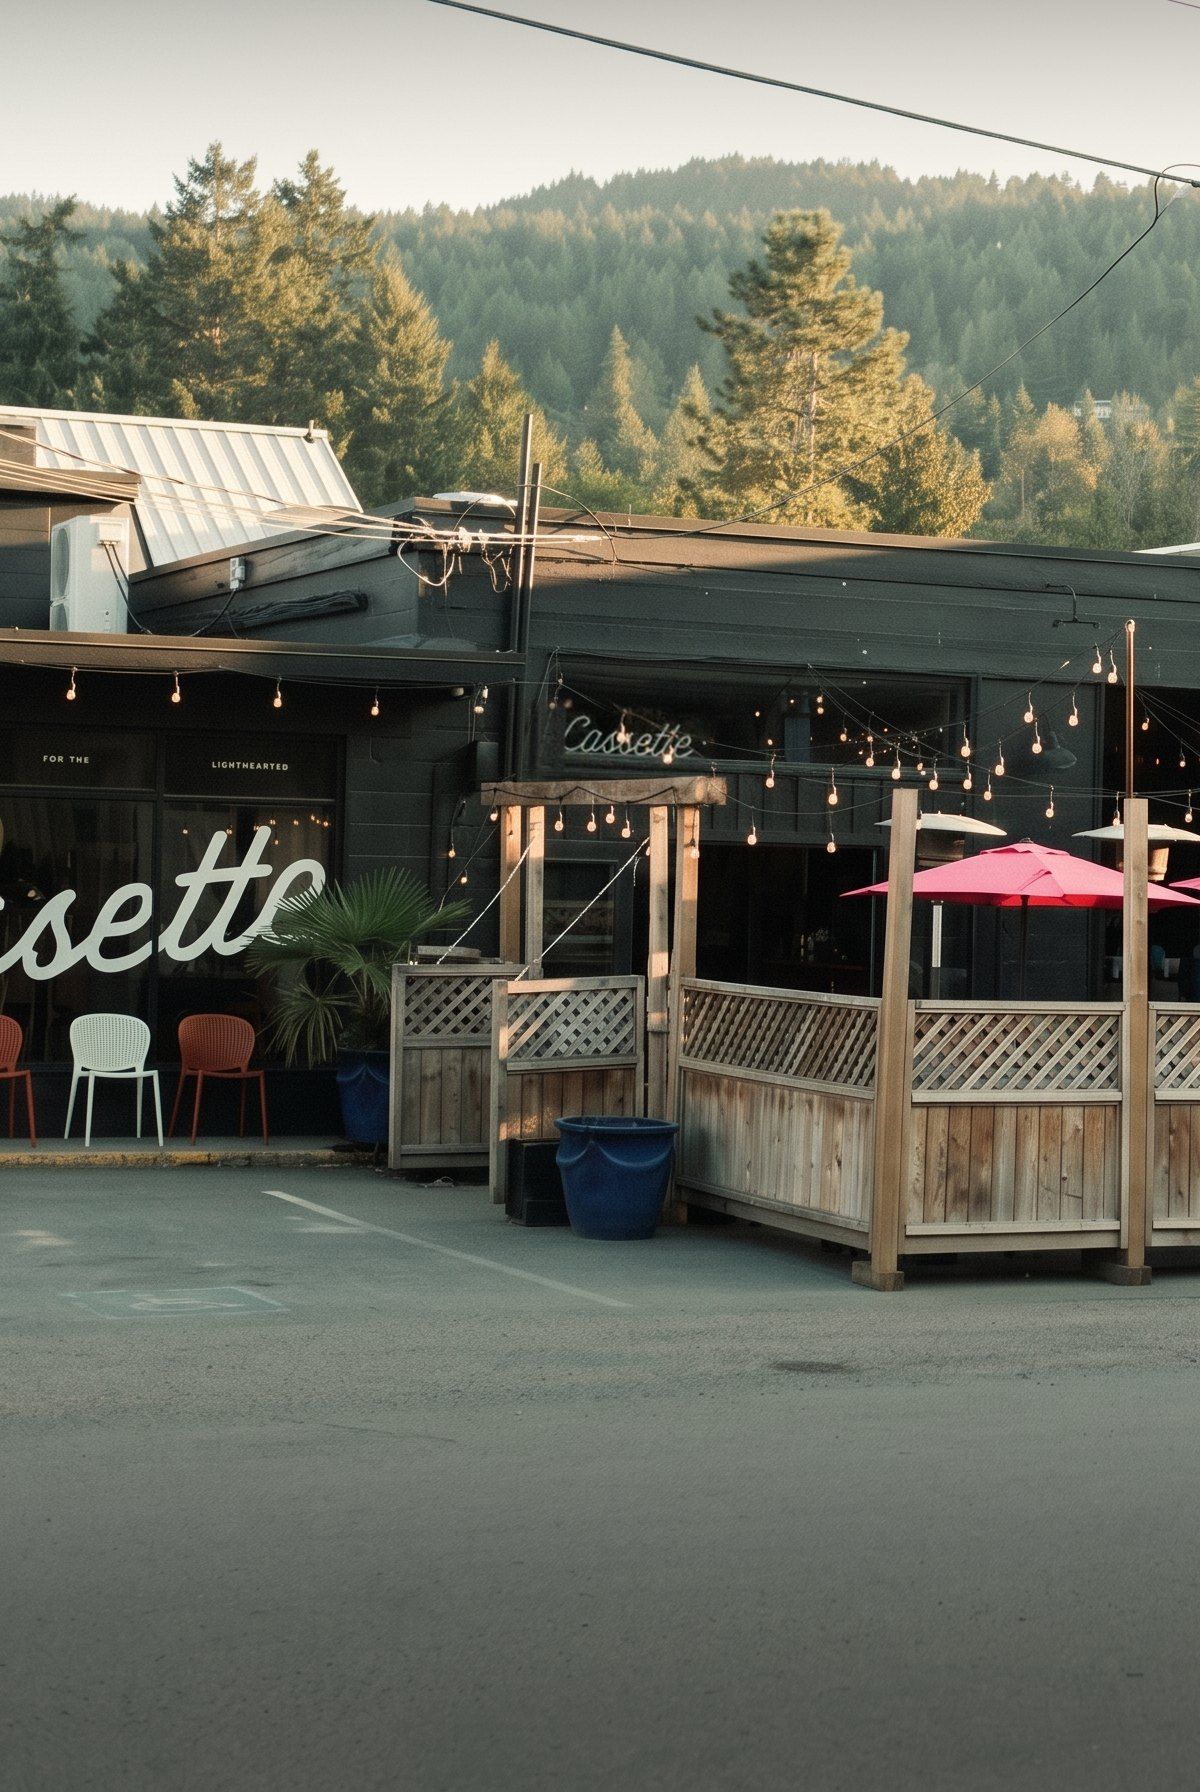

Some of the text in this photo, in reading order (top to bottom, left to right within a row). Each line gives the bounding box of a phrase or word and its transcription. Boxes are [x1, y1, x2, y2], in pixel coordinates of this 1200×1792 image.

[564, 715, 695, 758] Cassette
[43, 755, 90, 764] FOR THE
[212, 761, 289, 771] LIGHTHEARTED
[0, 825, 326, 981] sette
